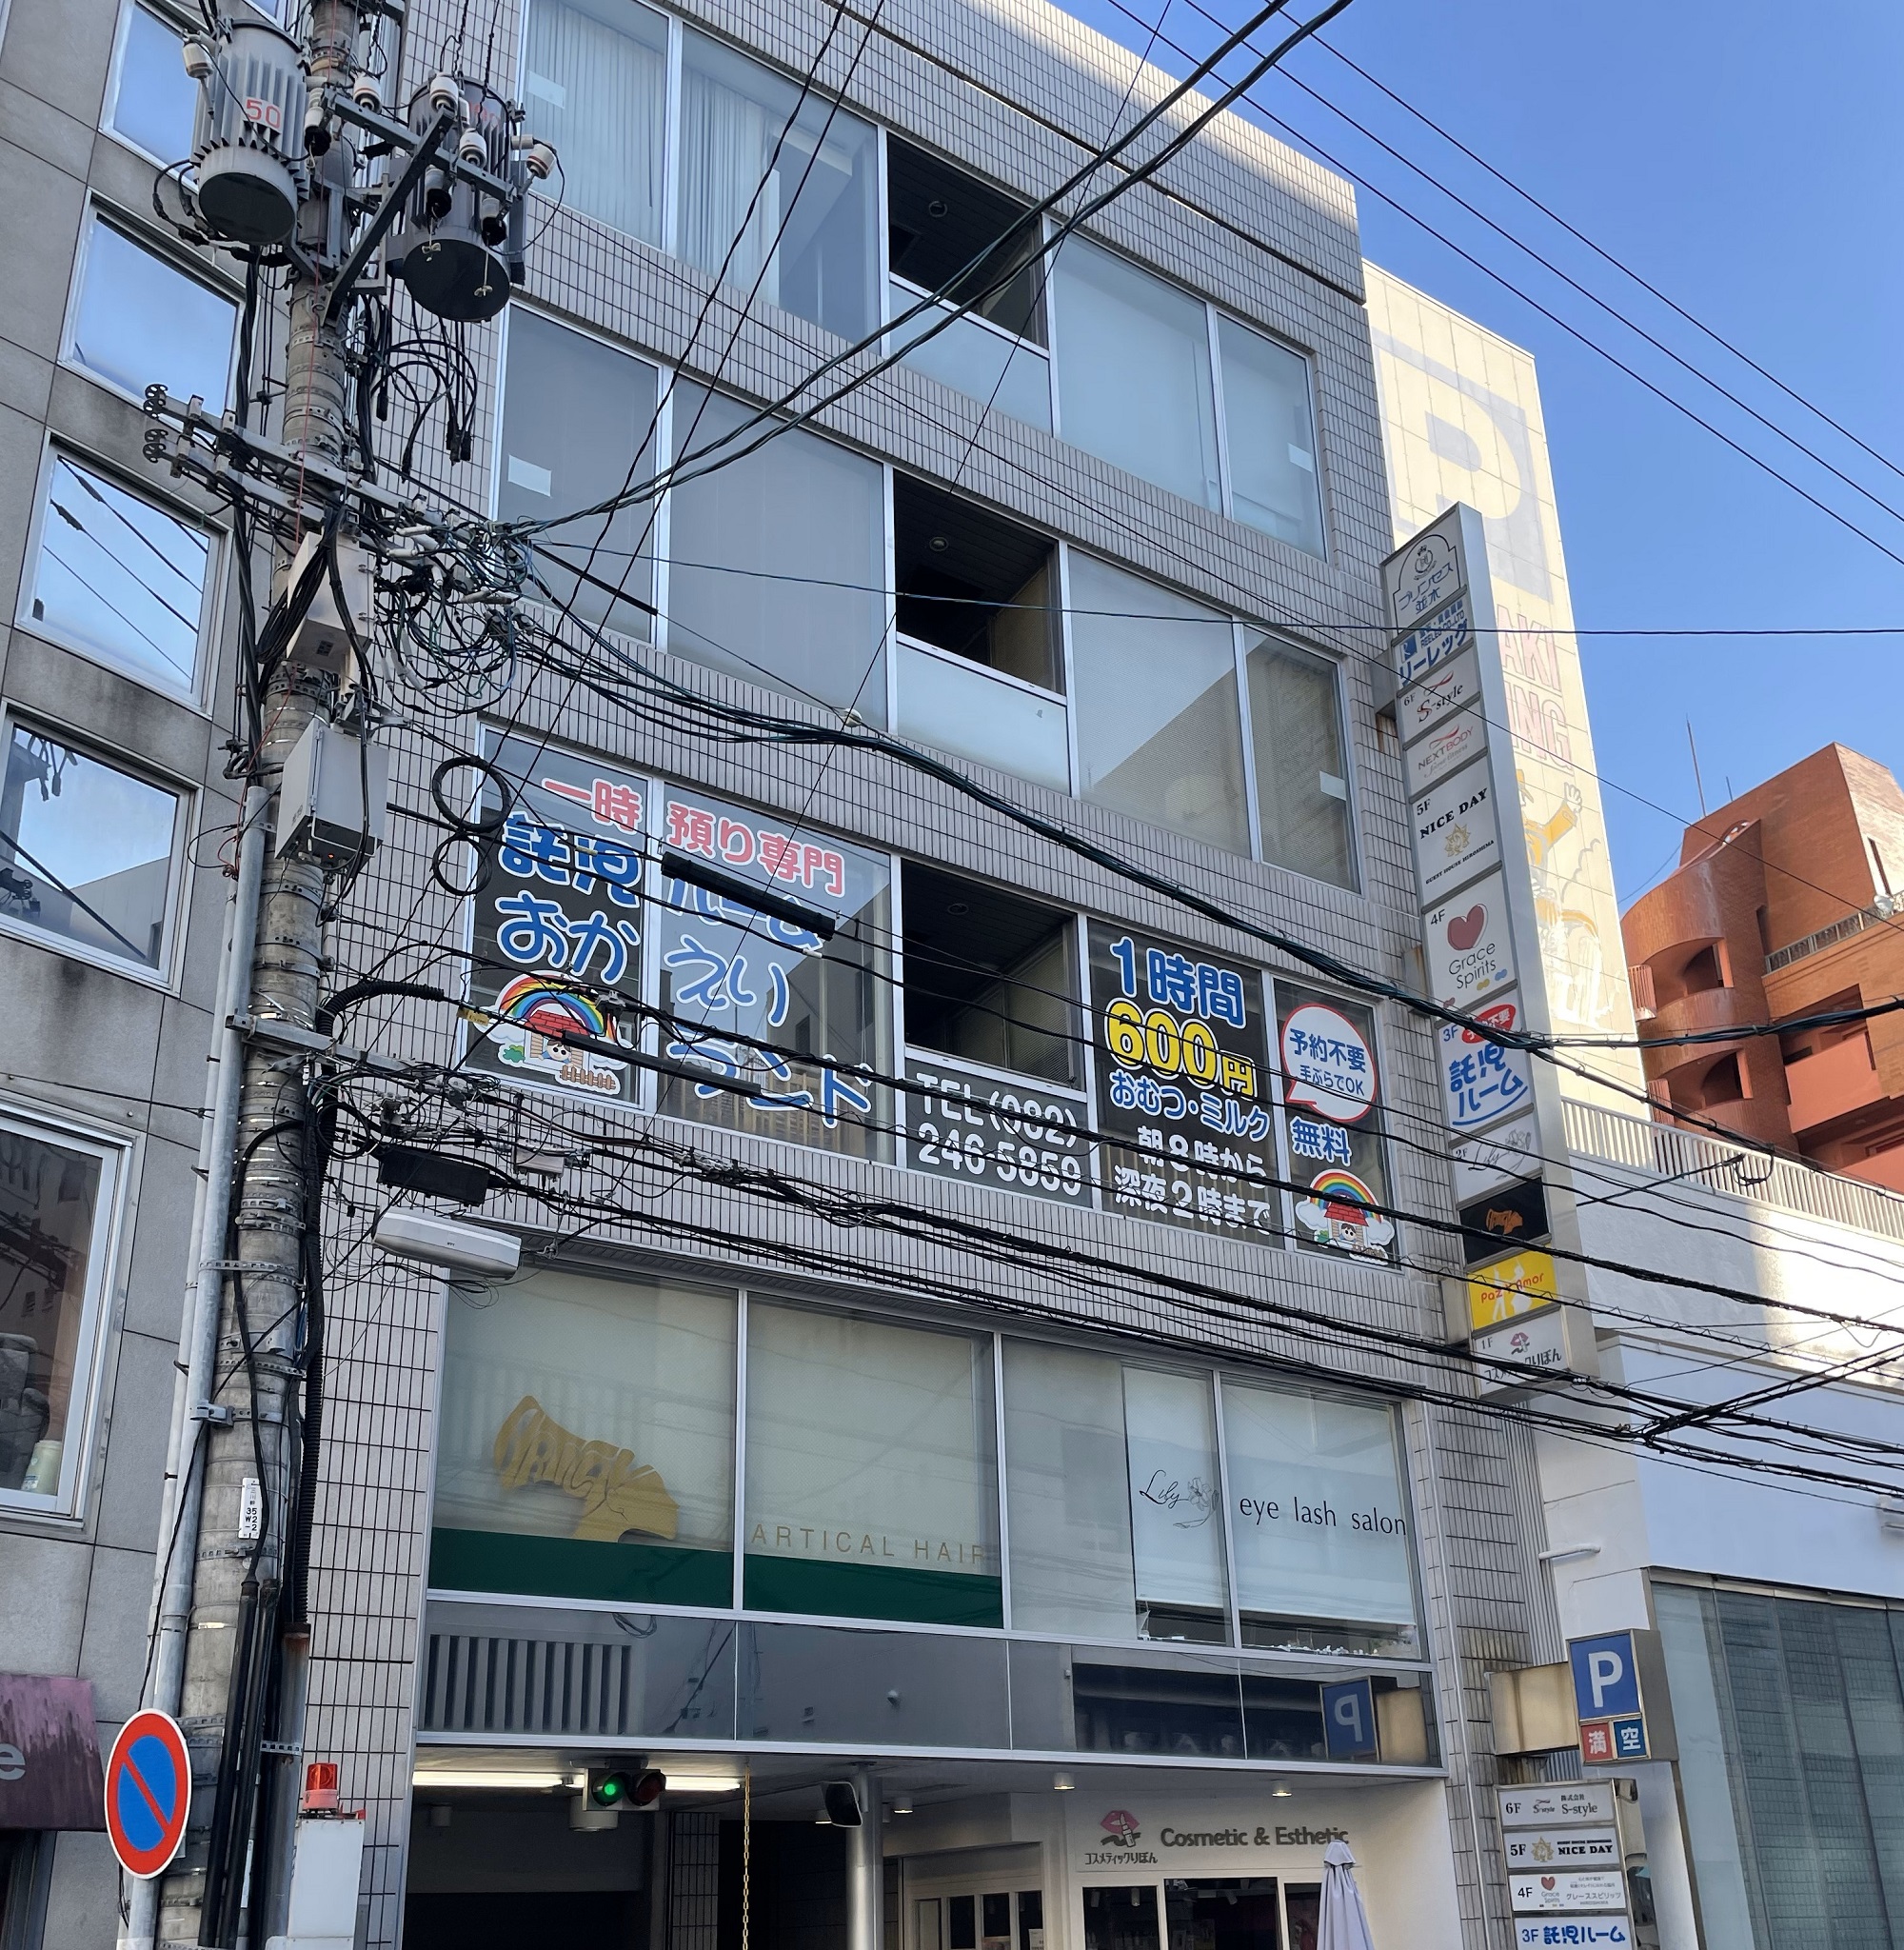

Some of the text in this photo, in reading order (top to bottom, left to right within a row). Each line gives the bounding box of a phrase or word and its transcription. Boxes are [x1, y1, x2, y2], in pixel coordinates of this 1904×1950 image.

[247, 99, 281, 129] 50
[1398, 562, 1454, 611] プリンセス
[1416, 587, 1441, 614] 並木
[1403, 692, 1416, 706] 6F
[1417, 685, 1464, 724] S-style
[1417, 799, 1431, 816] 5F
[1419, 787, 1488, 840] NICE DAY
[542, 777, 845, 898] 一時 預り専門
[1431, 908, 1446, 925] 4F
[495, 889, 641, 985] おか
[1448, 943, 1496, 975] Grace
[1456, 960, 1497, 989] Spirits
[1110, 936, 1247, 1028] 1時間
[1442, 1025, 1458, 1042] 3F
[1103, 997, 1258, 1102] 600円
[1289, 1027, 1366, 1073] 予約不要
[1449, 1043, 1506, 1092] 託児
[1458, 1068, 1523, 1118] ルーム
[1289, 1116, 1353, 1166] 無料
[1140, 1469, 1184, 1509] Lily
[1240, 1496, 1406, 1536] eye lash salon
[751, 1523, 986, 1564] ARTICAL HAIR
[1588, 1650, 1623, 1708] P
[1588, 1726, 1641, 1755] 満 空
[1505, 1802, 1521, 1814] 6F
[1561, 1802, 1598, 1817] S-style
[1160, 1826, 1349, 1847] Cosmetic & Esthetic
[1510, 1843, 1526, 1856] 5F
[1557, 1844, 1613, 1856] NICE DAY
[1084, 1852, 1158, 1864] コスメティックりぼん
[1517, 1886, 1533, 1898] 4F
[1521, 1925, 1626, 1945] 3F 託児ルーム
